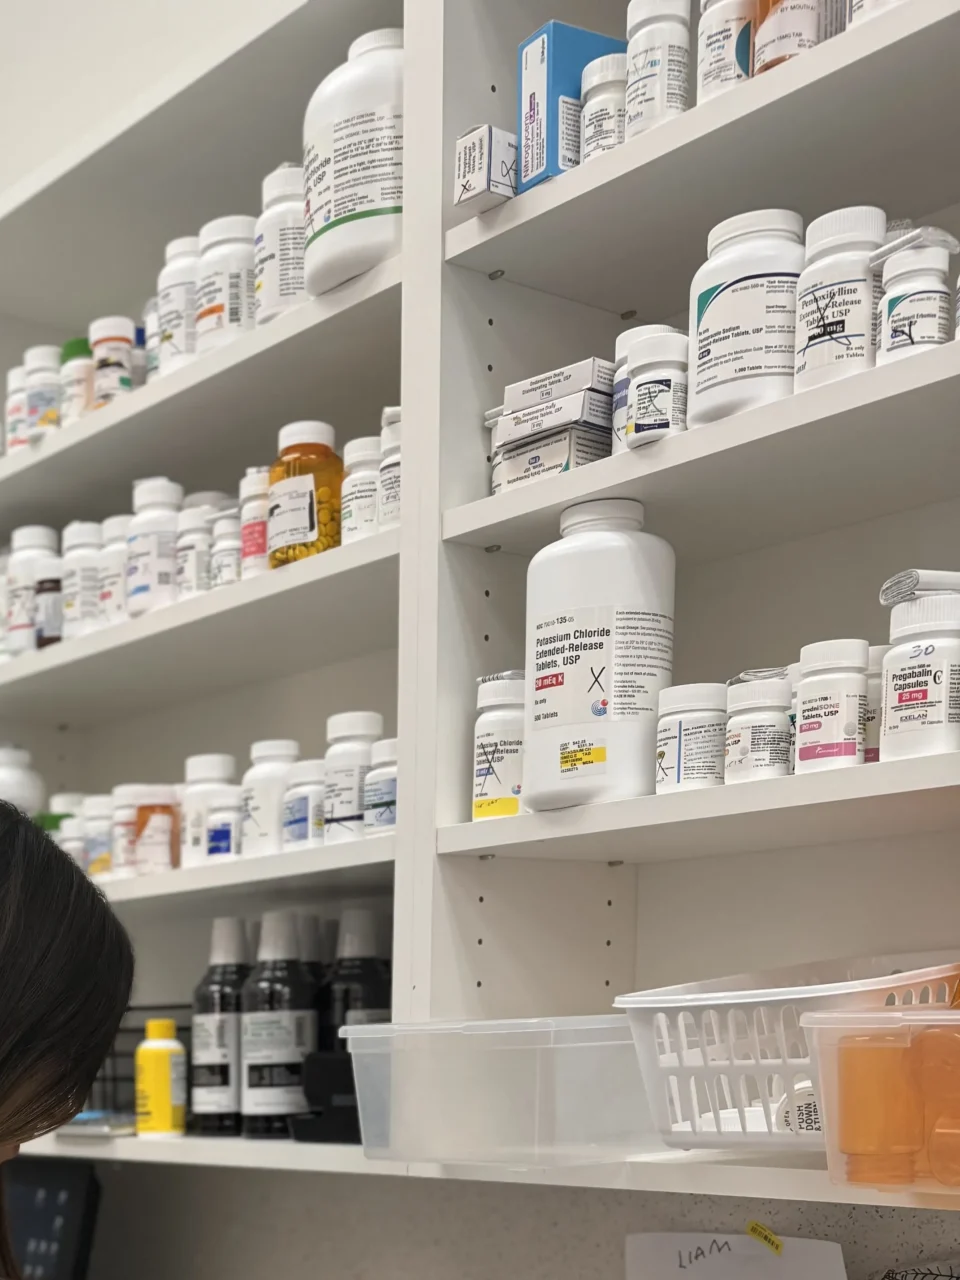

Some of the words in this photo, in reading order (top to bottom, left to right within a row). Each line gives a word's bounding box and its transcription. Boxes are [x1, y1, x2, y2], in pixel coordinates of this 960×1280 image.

[313, 171, 327, 188] USP
[832, 308, 851, 319] USP
[722, 325, 740, 334] Sodium
[731, 330, 751, 338] Tablets,
[536, 632, 571, 648] Potassium
[573, 627, 611, 640] Chloride
[535, 642, 604, 660] Extended-Release
[909, 644, 935, 659] 30
[535, 659, 561, 673] Tablets,
[562, 654, 581, 667] USP
[542, 676, 557, 687] mEq
[892, 668, 933, 683] Pregabalin
[894, 679, 929, 692] Capsules
[902, 692, 910, 700] 25
[911, 691, 923, 700] mg
[802, 702, 840, 715] predniSONE
[802, 712, 823, 721] Tablets,
[823, 709, 839, 717] USP
[541, 711, 558, 720] Tablets
[900, 713, 928, 722] EXELAN
[804, 1102, 814, 1131] DOWN
[678, 1239, 731, 1269] LIAM
